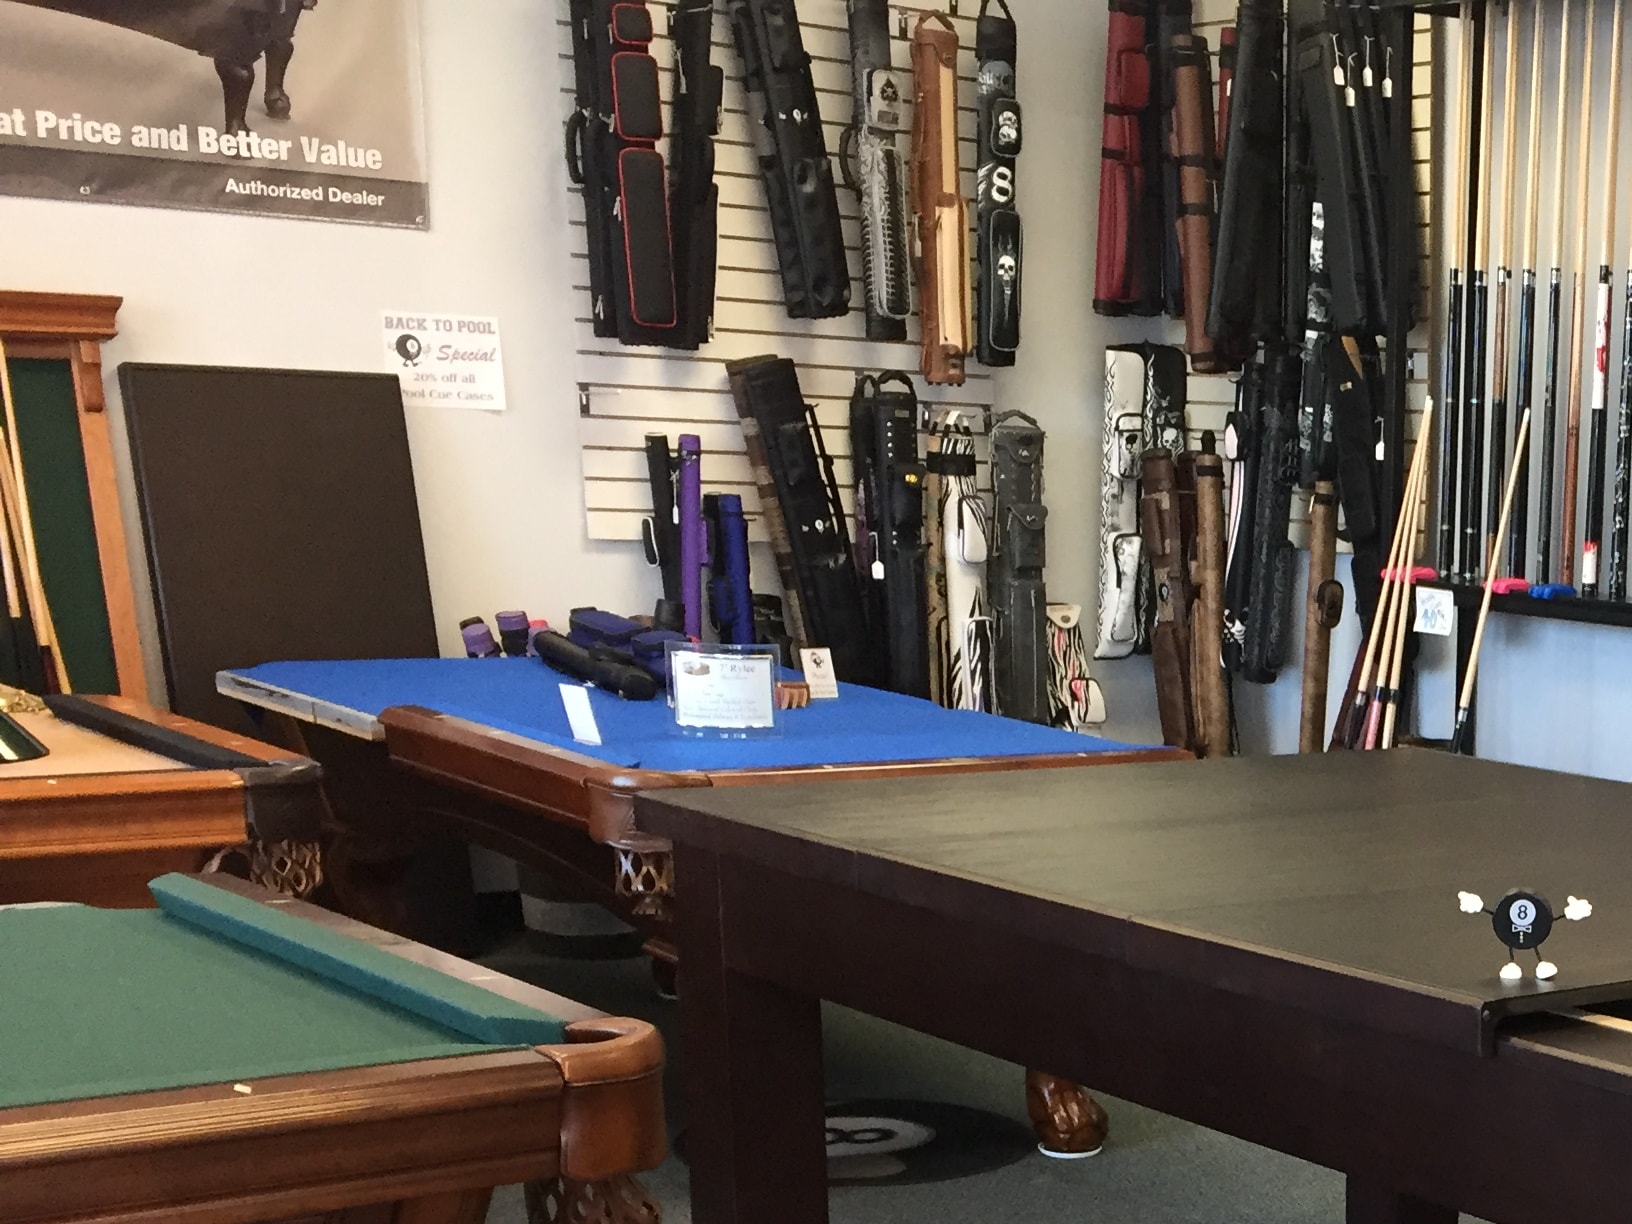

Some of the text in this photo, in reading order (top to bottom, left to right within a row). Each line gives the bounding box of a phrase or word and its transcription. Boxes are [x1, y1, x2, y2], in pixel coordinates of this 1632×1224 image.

[35, 109, 121, 145] Price
[131, 124, 188, 152] and
[197, 126, 292, 161] Better
[300, 136, 383, 170] Value
[225, 178, 385, 206] Authorized Dealer
[384, 316, 496, 334] BACK TO POOL
[436, 344, 497, 364] Special
[441, 373, 457, 383] off
[461, 374, 477, 383] all
[429, 389, 453, 399] Cue
[457, 391, 494, 401] Cases
[1517, 904, 1528, 920] 8
